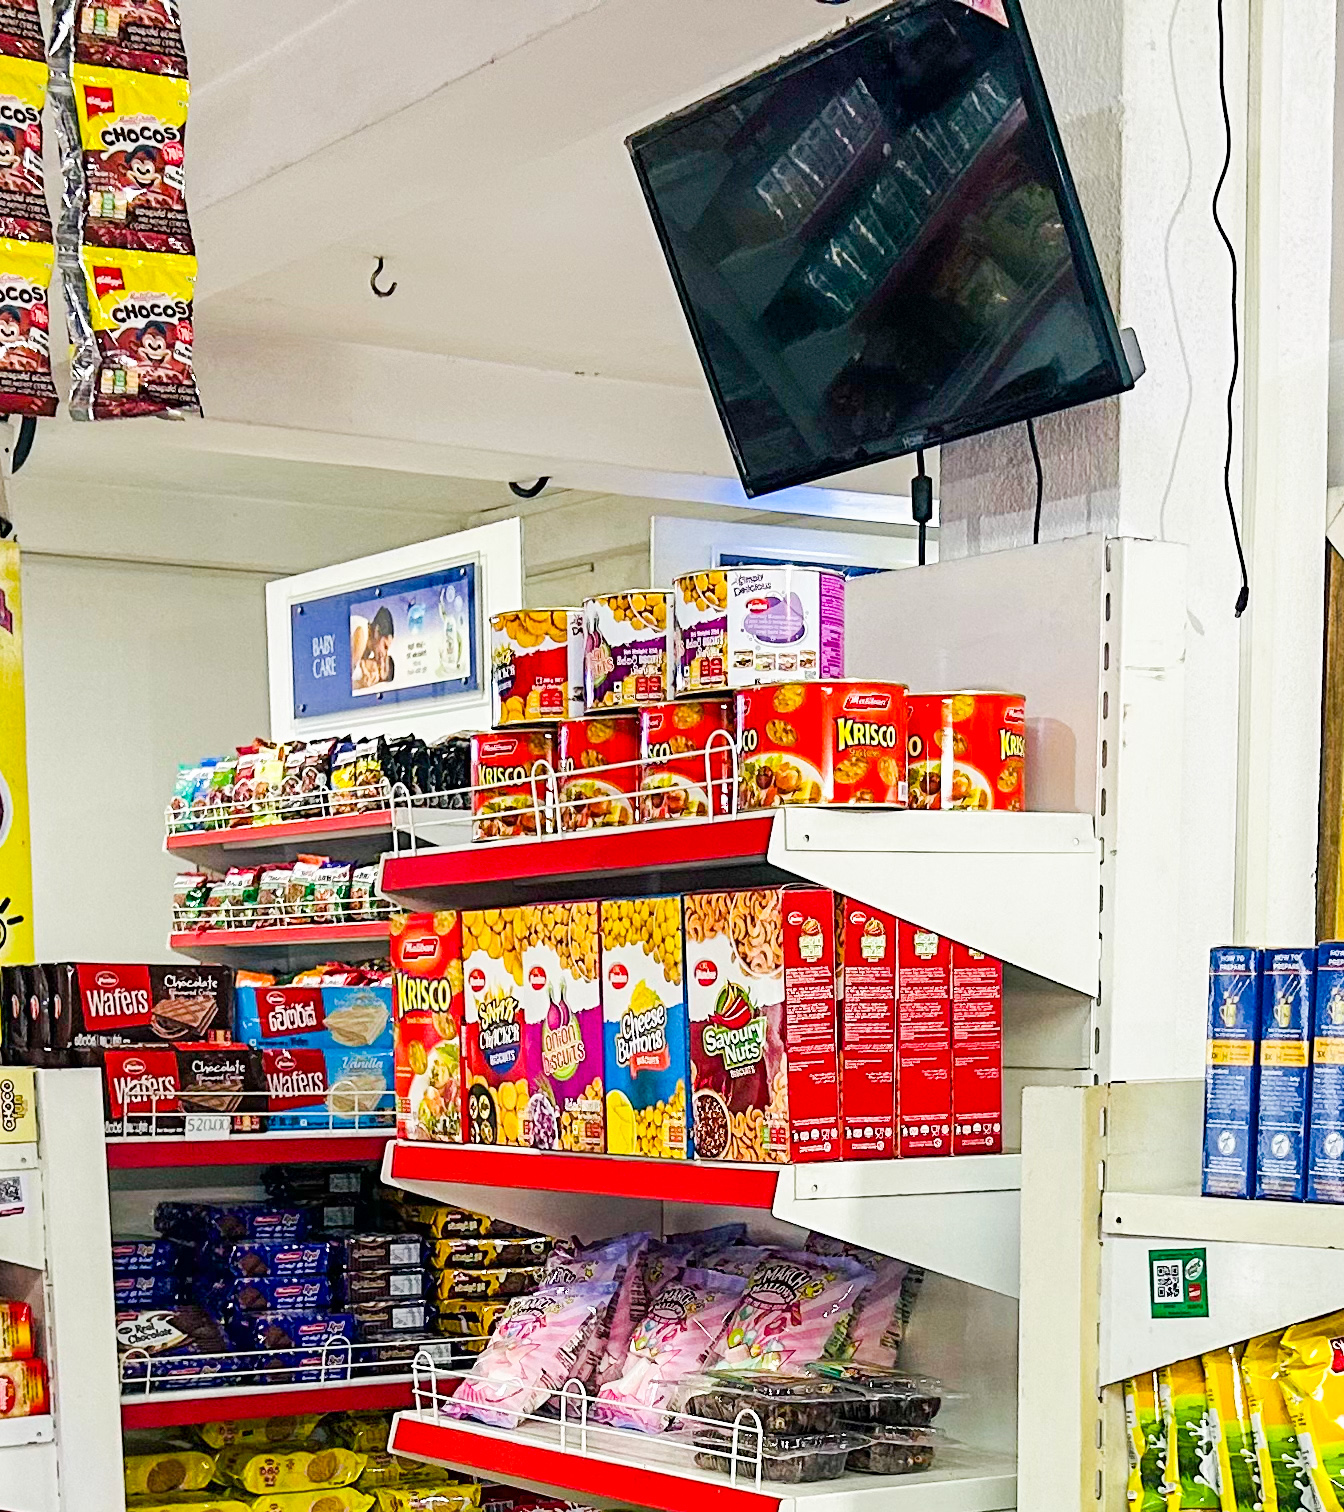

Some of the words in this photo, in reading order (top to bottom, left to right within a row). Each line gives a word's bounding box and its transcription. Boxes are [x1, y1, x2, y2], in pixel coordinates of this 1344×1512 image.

[101, 126, 177, 146] CHOCOS
[312, 634, 336, 657] BABY
[312, 656, 337, 679] CARE
[838, 717, 896, 748] KRISCO
[481, 765, 525, 786] KRISCO
[164, 974, 218, 989] Chocolate
[397, 973, 450, 1012] KRISCO
[86, 987, 148, 1018] Wafers
[622, 1007, 665, 1038] Cheese
[704, 1020, 767, 1049] Savoury
[617, 1032, 662, 1066] Buttons
[724, 1040, 760, 1062] Nuts
[192, 1059, 246, 1074] Chocolate
[342, 1057, 383, 1069] Vanilla
